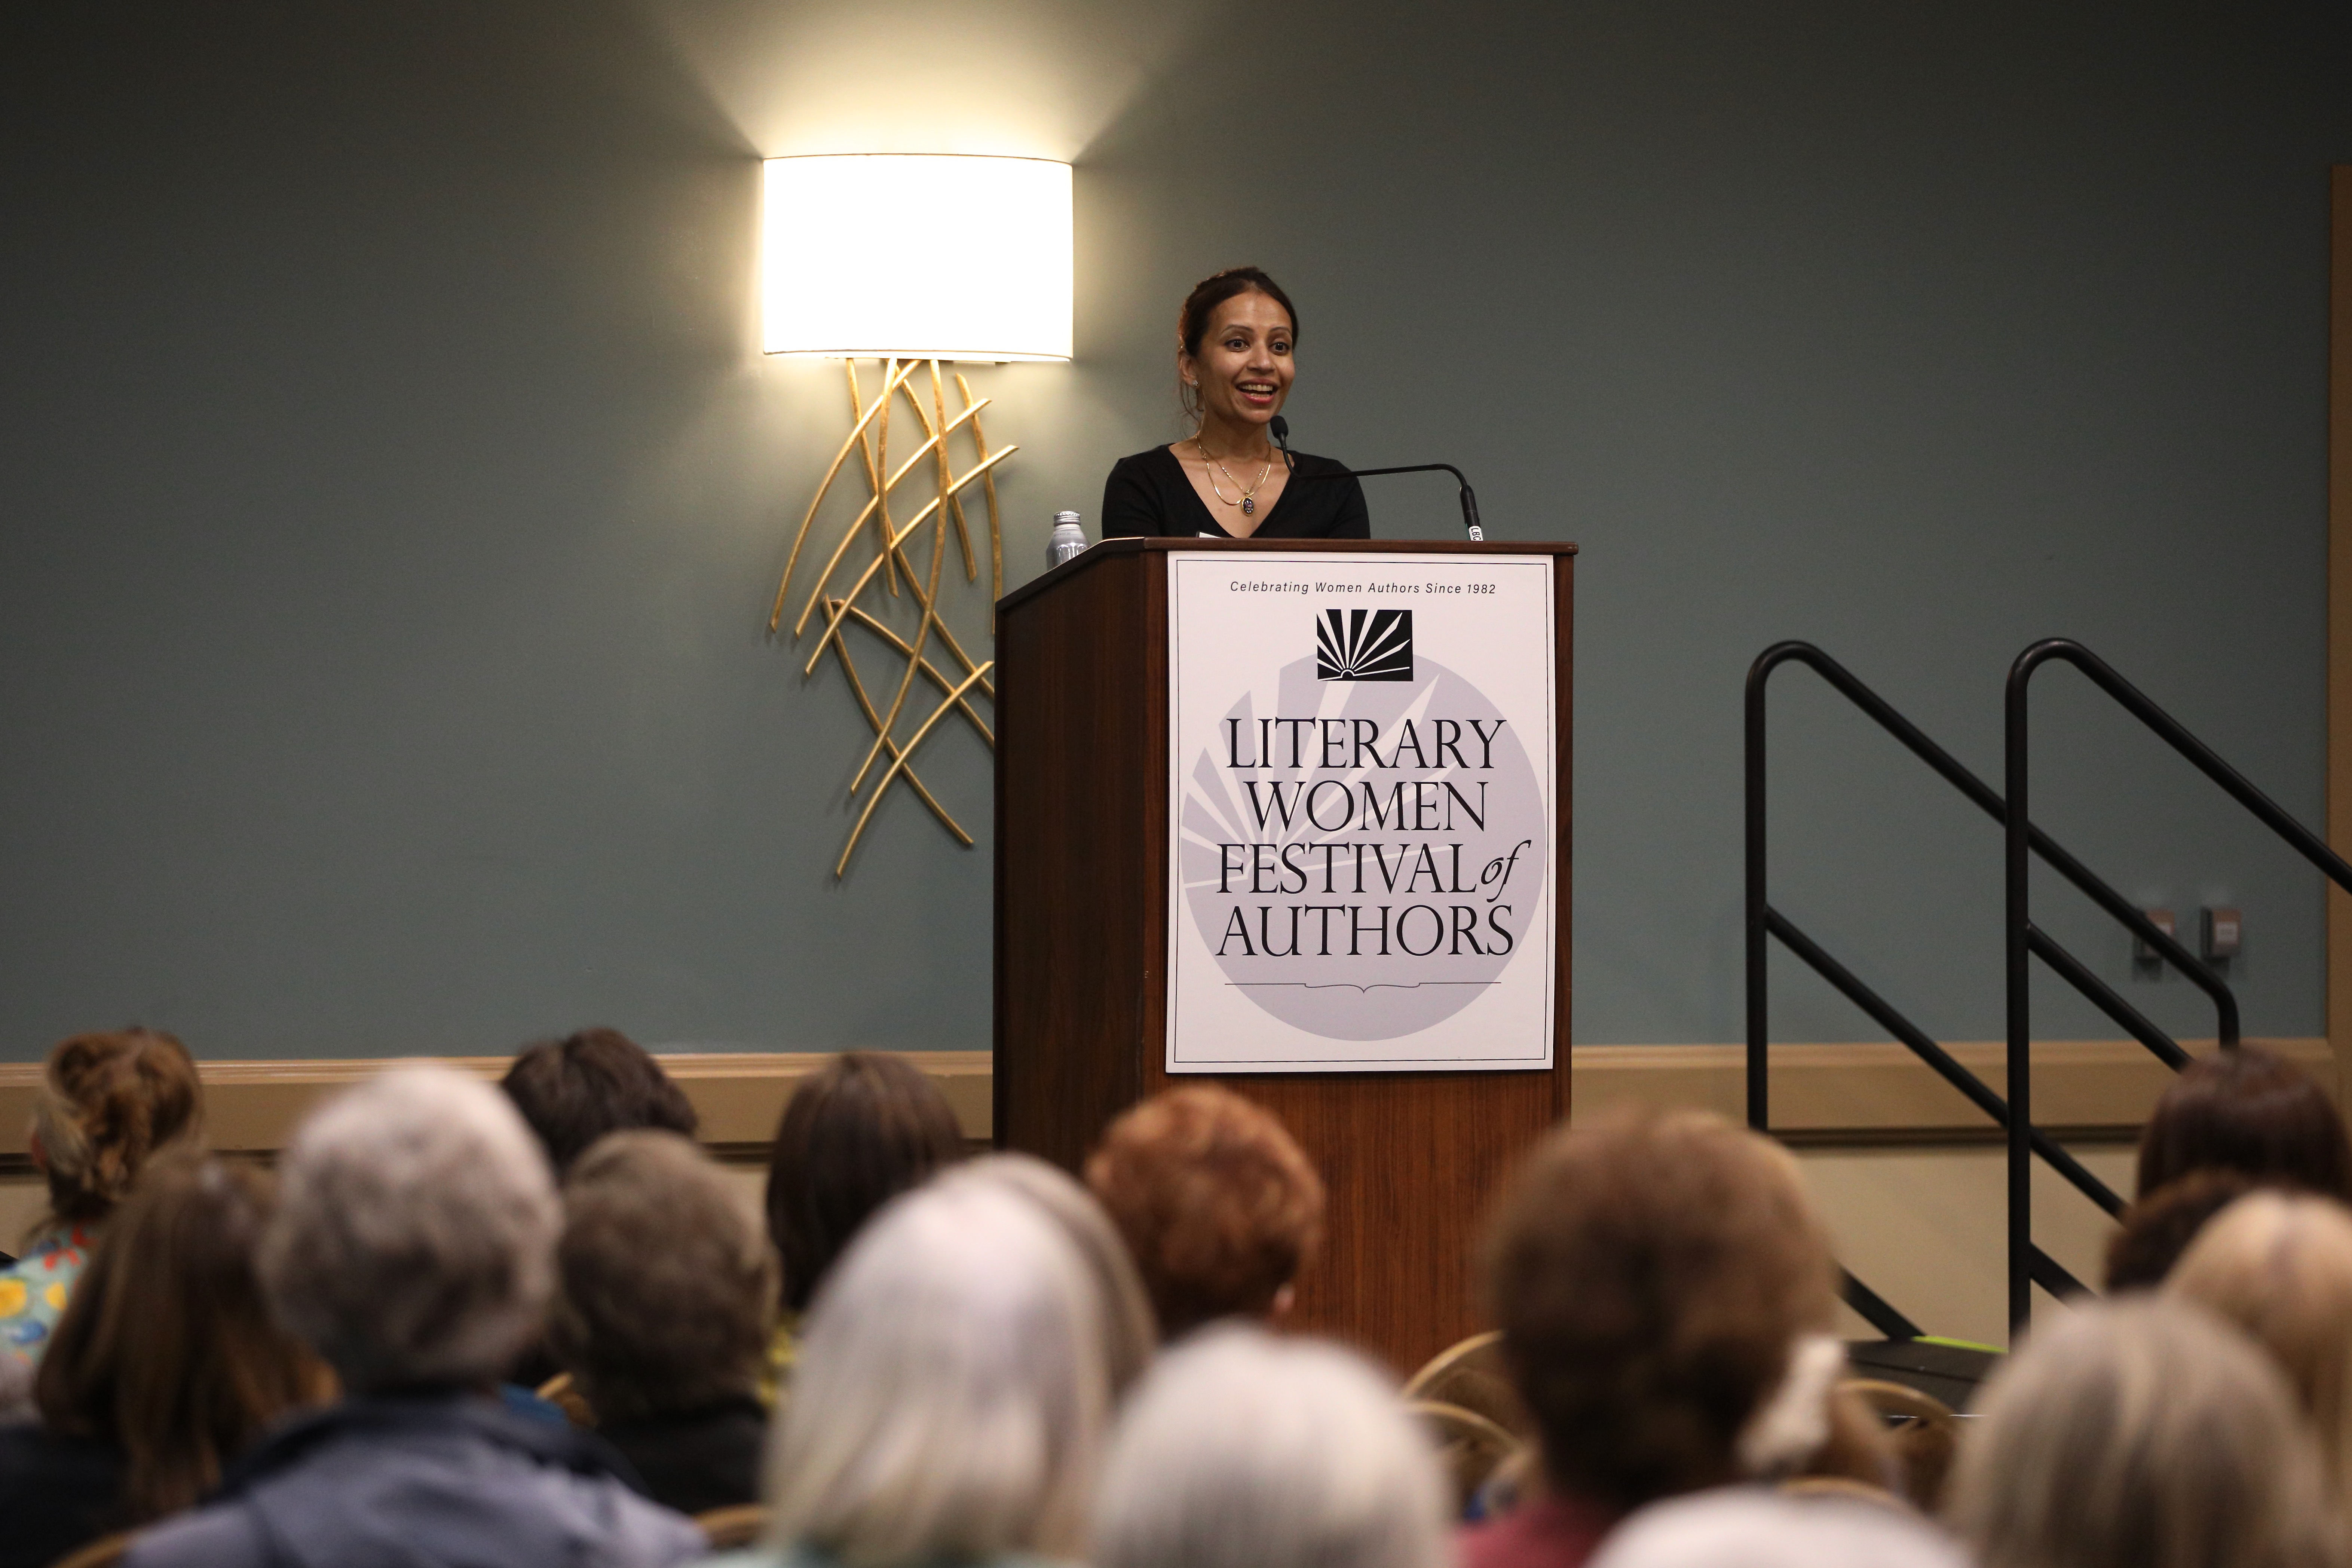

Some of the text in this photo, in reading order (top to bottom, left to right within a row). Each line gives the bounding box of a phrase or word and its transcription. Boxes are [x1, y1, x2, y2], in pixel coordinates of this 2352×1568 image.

[1471, 528, 1481, 540] LBC
[1230, 581, 1495, 595] Celebrating Women Authors Since 1982
[1226, 717, 1507, 768] LITERARY
[1243, 780, 1488, 832] WOMEN
[1217, 840, 1531, 903] FESTIVAL of
[1215, 904, 1513, 956] AUTHORS
